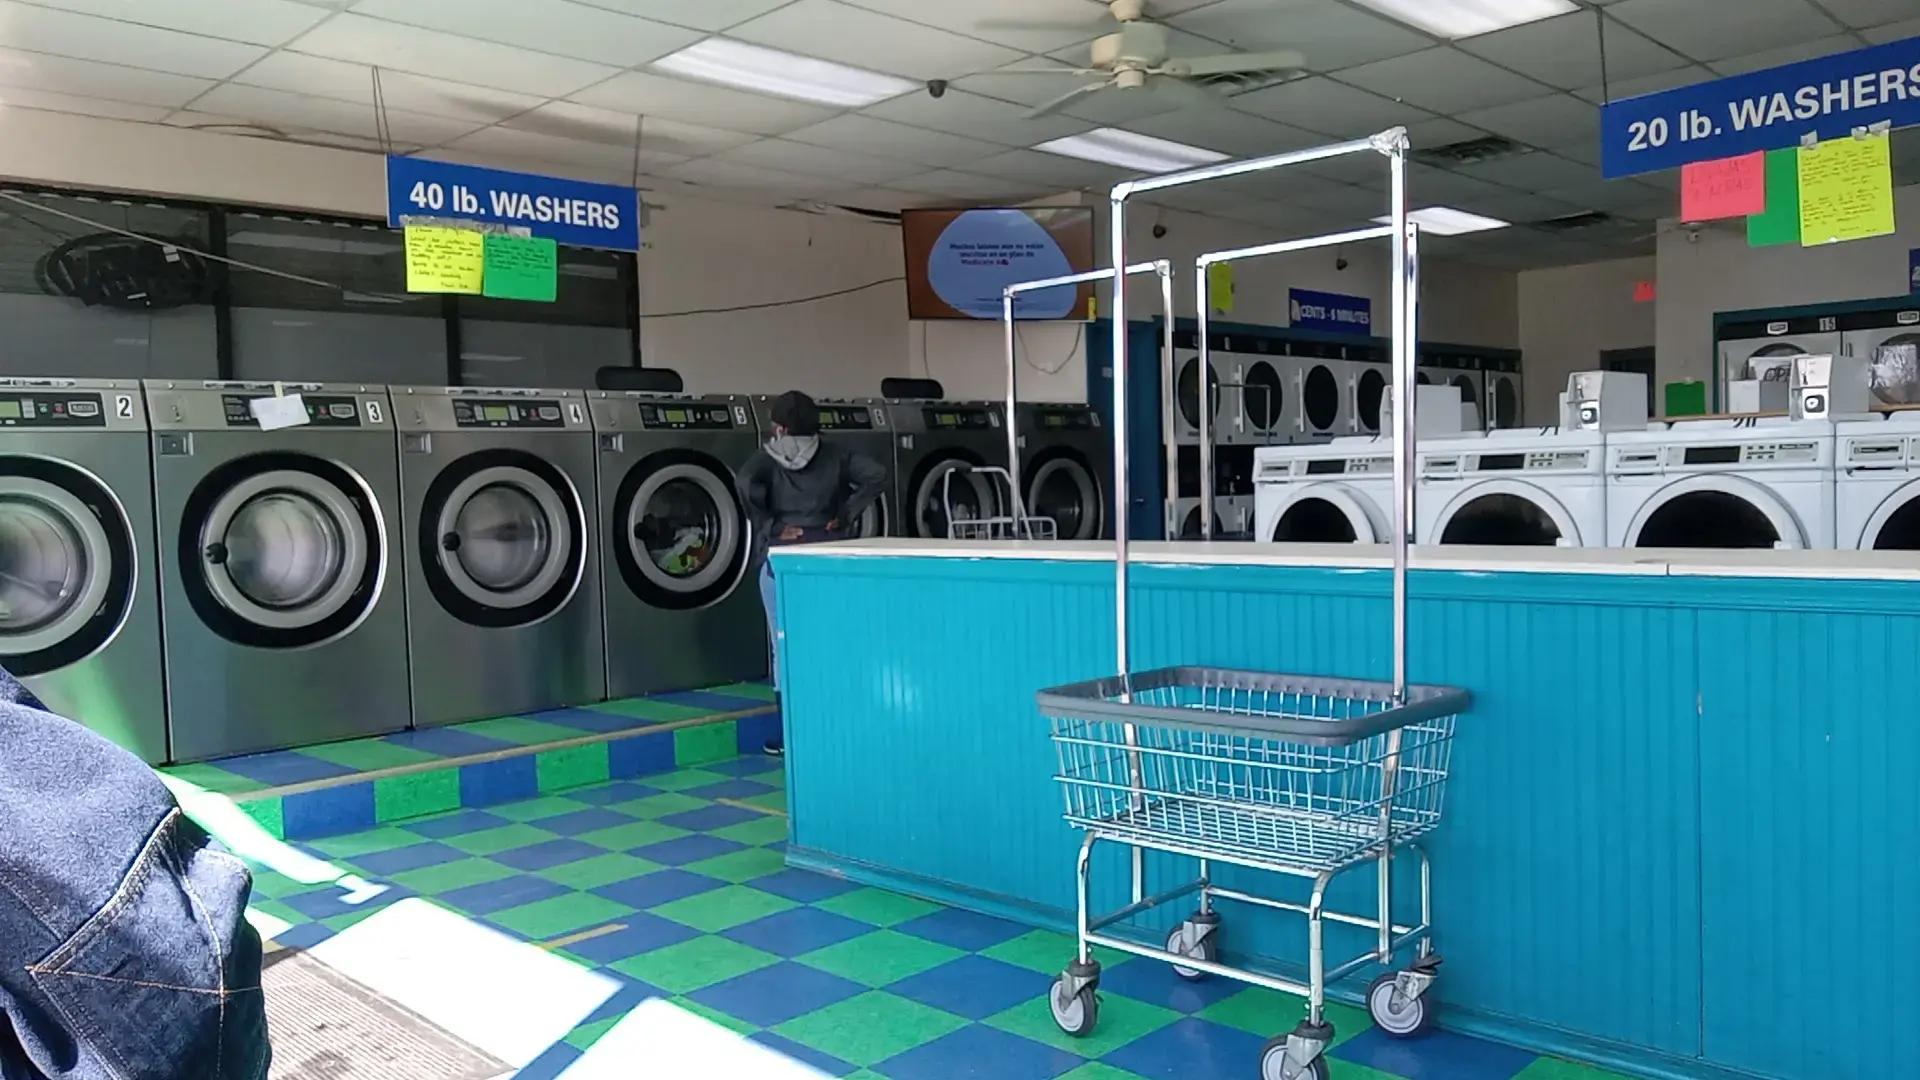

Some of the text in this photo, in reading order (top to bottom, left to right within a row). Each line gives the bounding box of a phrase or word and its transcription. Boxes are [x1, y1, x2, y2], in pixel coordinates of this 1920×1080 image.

[1628, 117, 1668, 151] 20
[1680, 109, 1721, 142] lb.
[409, 181, 620, 231] 40 lb. WASHERS
[1300, 305, 1325, 320] CENTS
[118, 397, 131, 417] 2
[369, 403, 380, 421] 3
